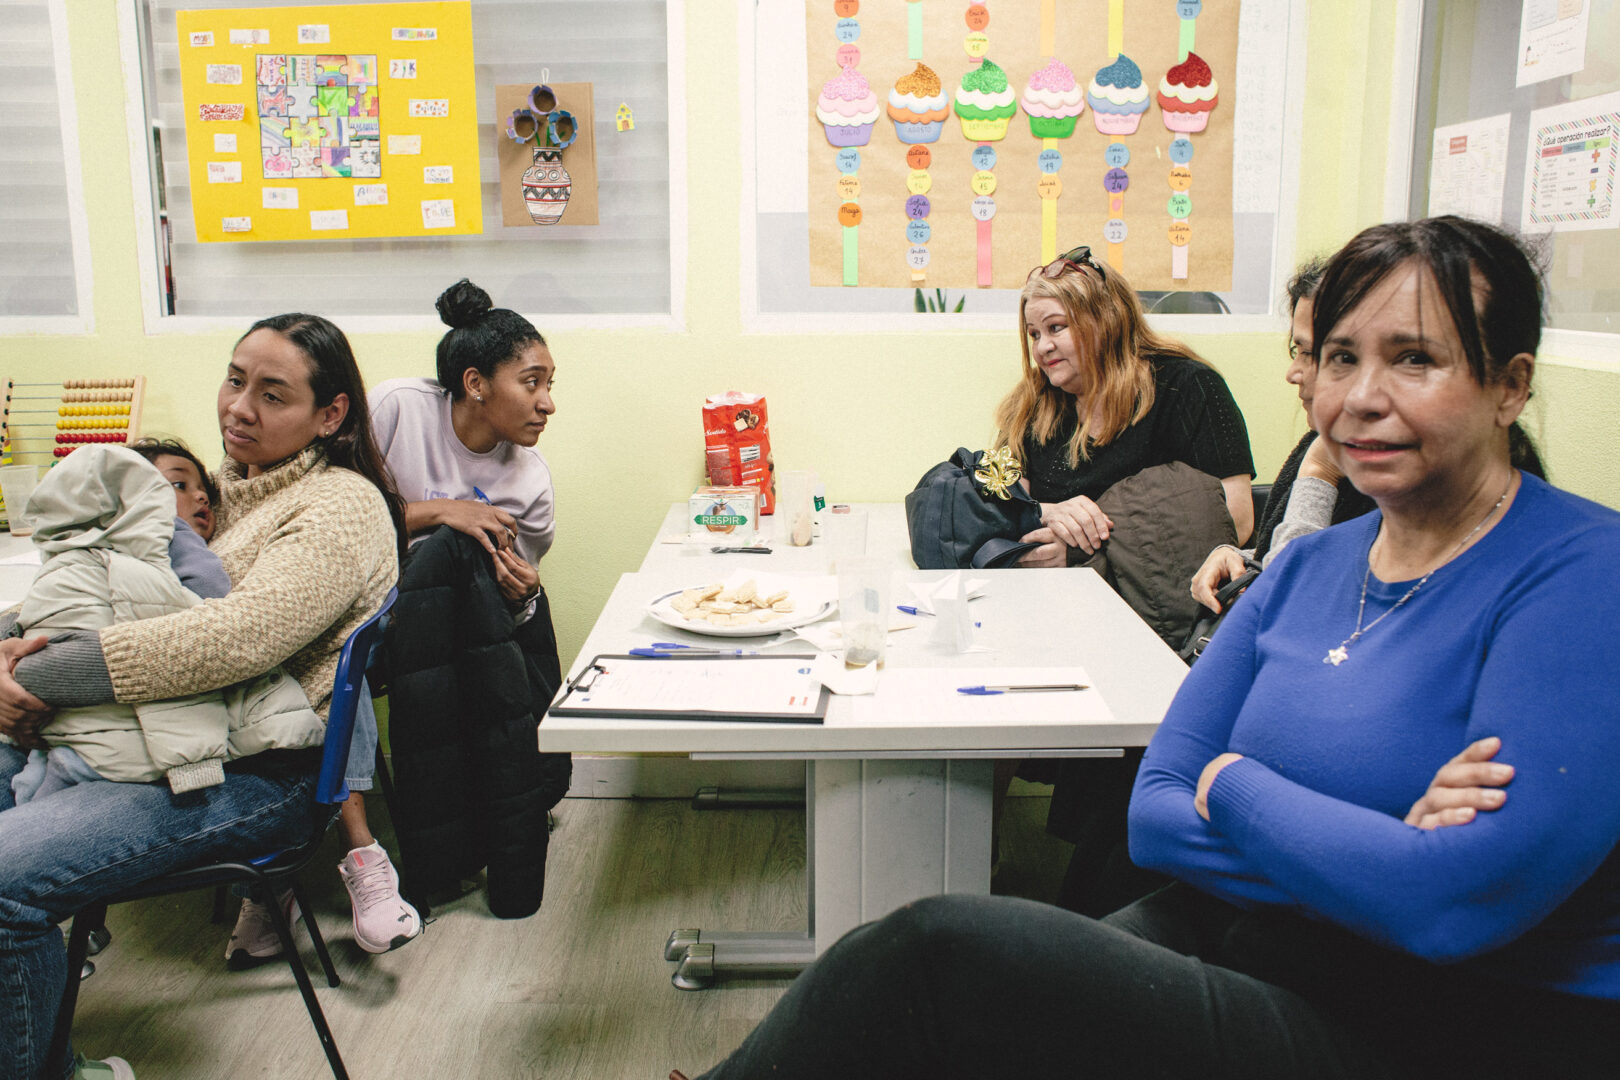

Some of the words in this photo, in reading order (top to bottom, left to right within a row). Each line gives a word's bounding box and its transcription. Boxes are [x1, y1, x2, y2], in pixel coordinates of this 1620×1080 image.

[840, 128, 860, 136] JULIO
[1543, 137, 1556, 146] ¿Qué
[1557, 132, 1584, 144] operación
[1585, 125, 1611, 137] realizar?
[913, 208, 923, 217] 24
[979, 208, 988, 217] 18
[913, 231, 924, 239] 26
[1110, 231, 1123, 240] 22
[914, 256, 925, 265] 27
[702, 516, 740, 525] RESPIR
